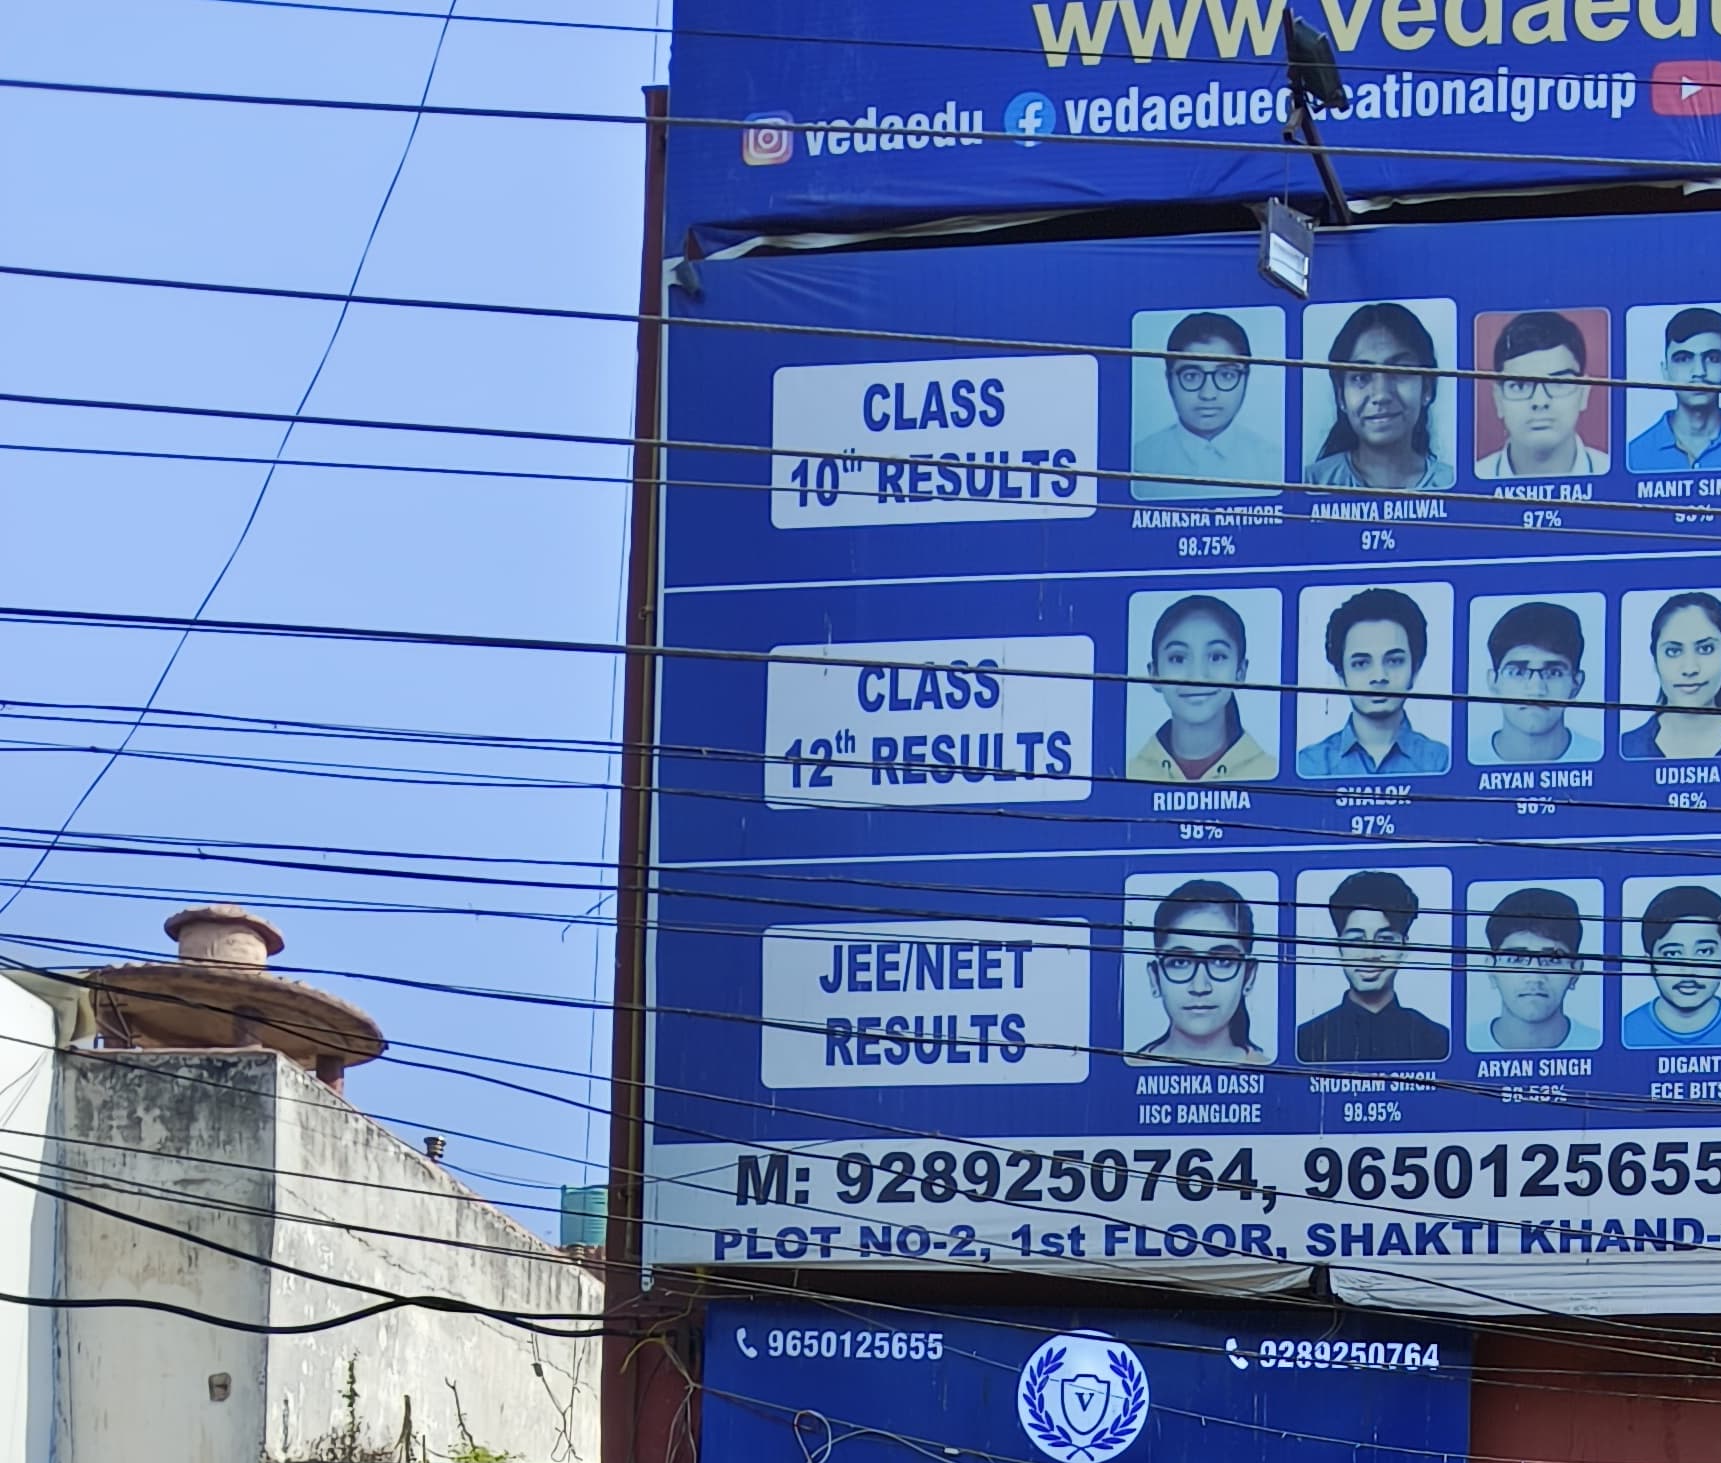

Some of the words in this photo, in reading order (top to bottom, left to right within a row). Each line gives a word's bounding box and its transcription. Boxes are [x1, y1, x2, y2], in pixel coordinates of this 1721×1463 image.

[803, 100, 984, 157] vedaedu
[863, 379, 1005, 432] CLASS
[878, 449, 1077, 503] RESULTS
[1494, 485, 1555, 501] AKSHIT
[1560, 484, 1592, 501] RAJ
[1638, 480, 1693, 499] MANIT
[1132, 509, 1210, 528] AKANKSHA
[1384, 500, 1447, 520] BAILWAL
[1523, 511, 1561, 528] 97%
[1178, 536, 1236, 556] 98.75%
[1361, 530, 1395, 550] 97%
[857, 658, 1000, 712] CLASS
[785, 729, 855, 788] 12th
[872, 731, 1071, 785] RESULTS
[1479, 772, 1535, 791] ARYAN
[1540, 770, 1593, 788] SINGH
[1655, 765, 1721, 785] UDISHA
[1153, 790, 1251, 811] RIDDHIMA
[1667, 791, 1707, 810] 96%
[1351, 815, 1395, 836] 97%
[819, 940, 1032, 993] JEE/NEET
[825, 1013, 1026, 1065] RESULTS
[1477, 1060, 1533, 1078] ARYAN
[1538, 1058, 1592, 1077] SINGH
[1658, 1055, 1721, 1074] DIGANT
[1136, 1075, 1213, 1096] ANUSHKA
[1217, 1073, 1264, 1094] DASSI
[1650, 1082, 1686, 1100] ECE
[1177, 1102, 1261, 1124] BANGLORE
[1344, 1102, 1401, 1122] 98.95%
[735, 1154, 809, 1206] M:
[835, 1147, 1278, 1212] 9289250764,
[713, 1225, 841, 1261] PLOT
[859, 1223, 991, 1264] NO-2,
[1018, 1223, 1086, 1257] 1st
[1104, 1222, 1287, 1260] FLOOR,
[1306, 1220, 1498, 1257] SHAKTI
[767, 1332, 944, 1361] 9650125655
[1259, 1340, 1439, 1370] 9289250764
